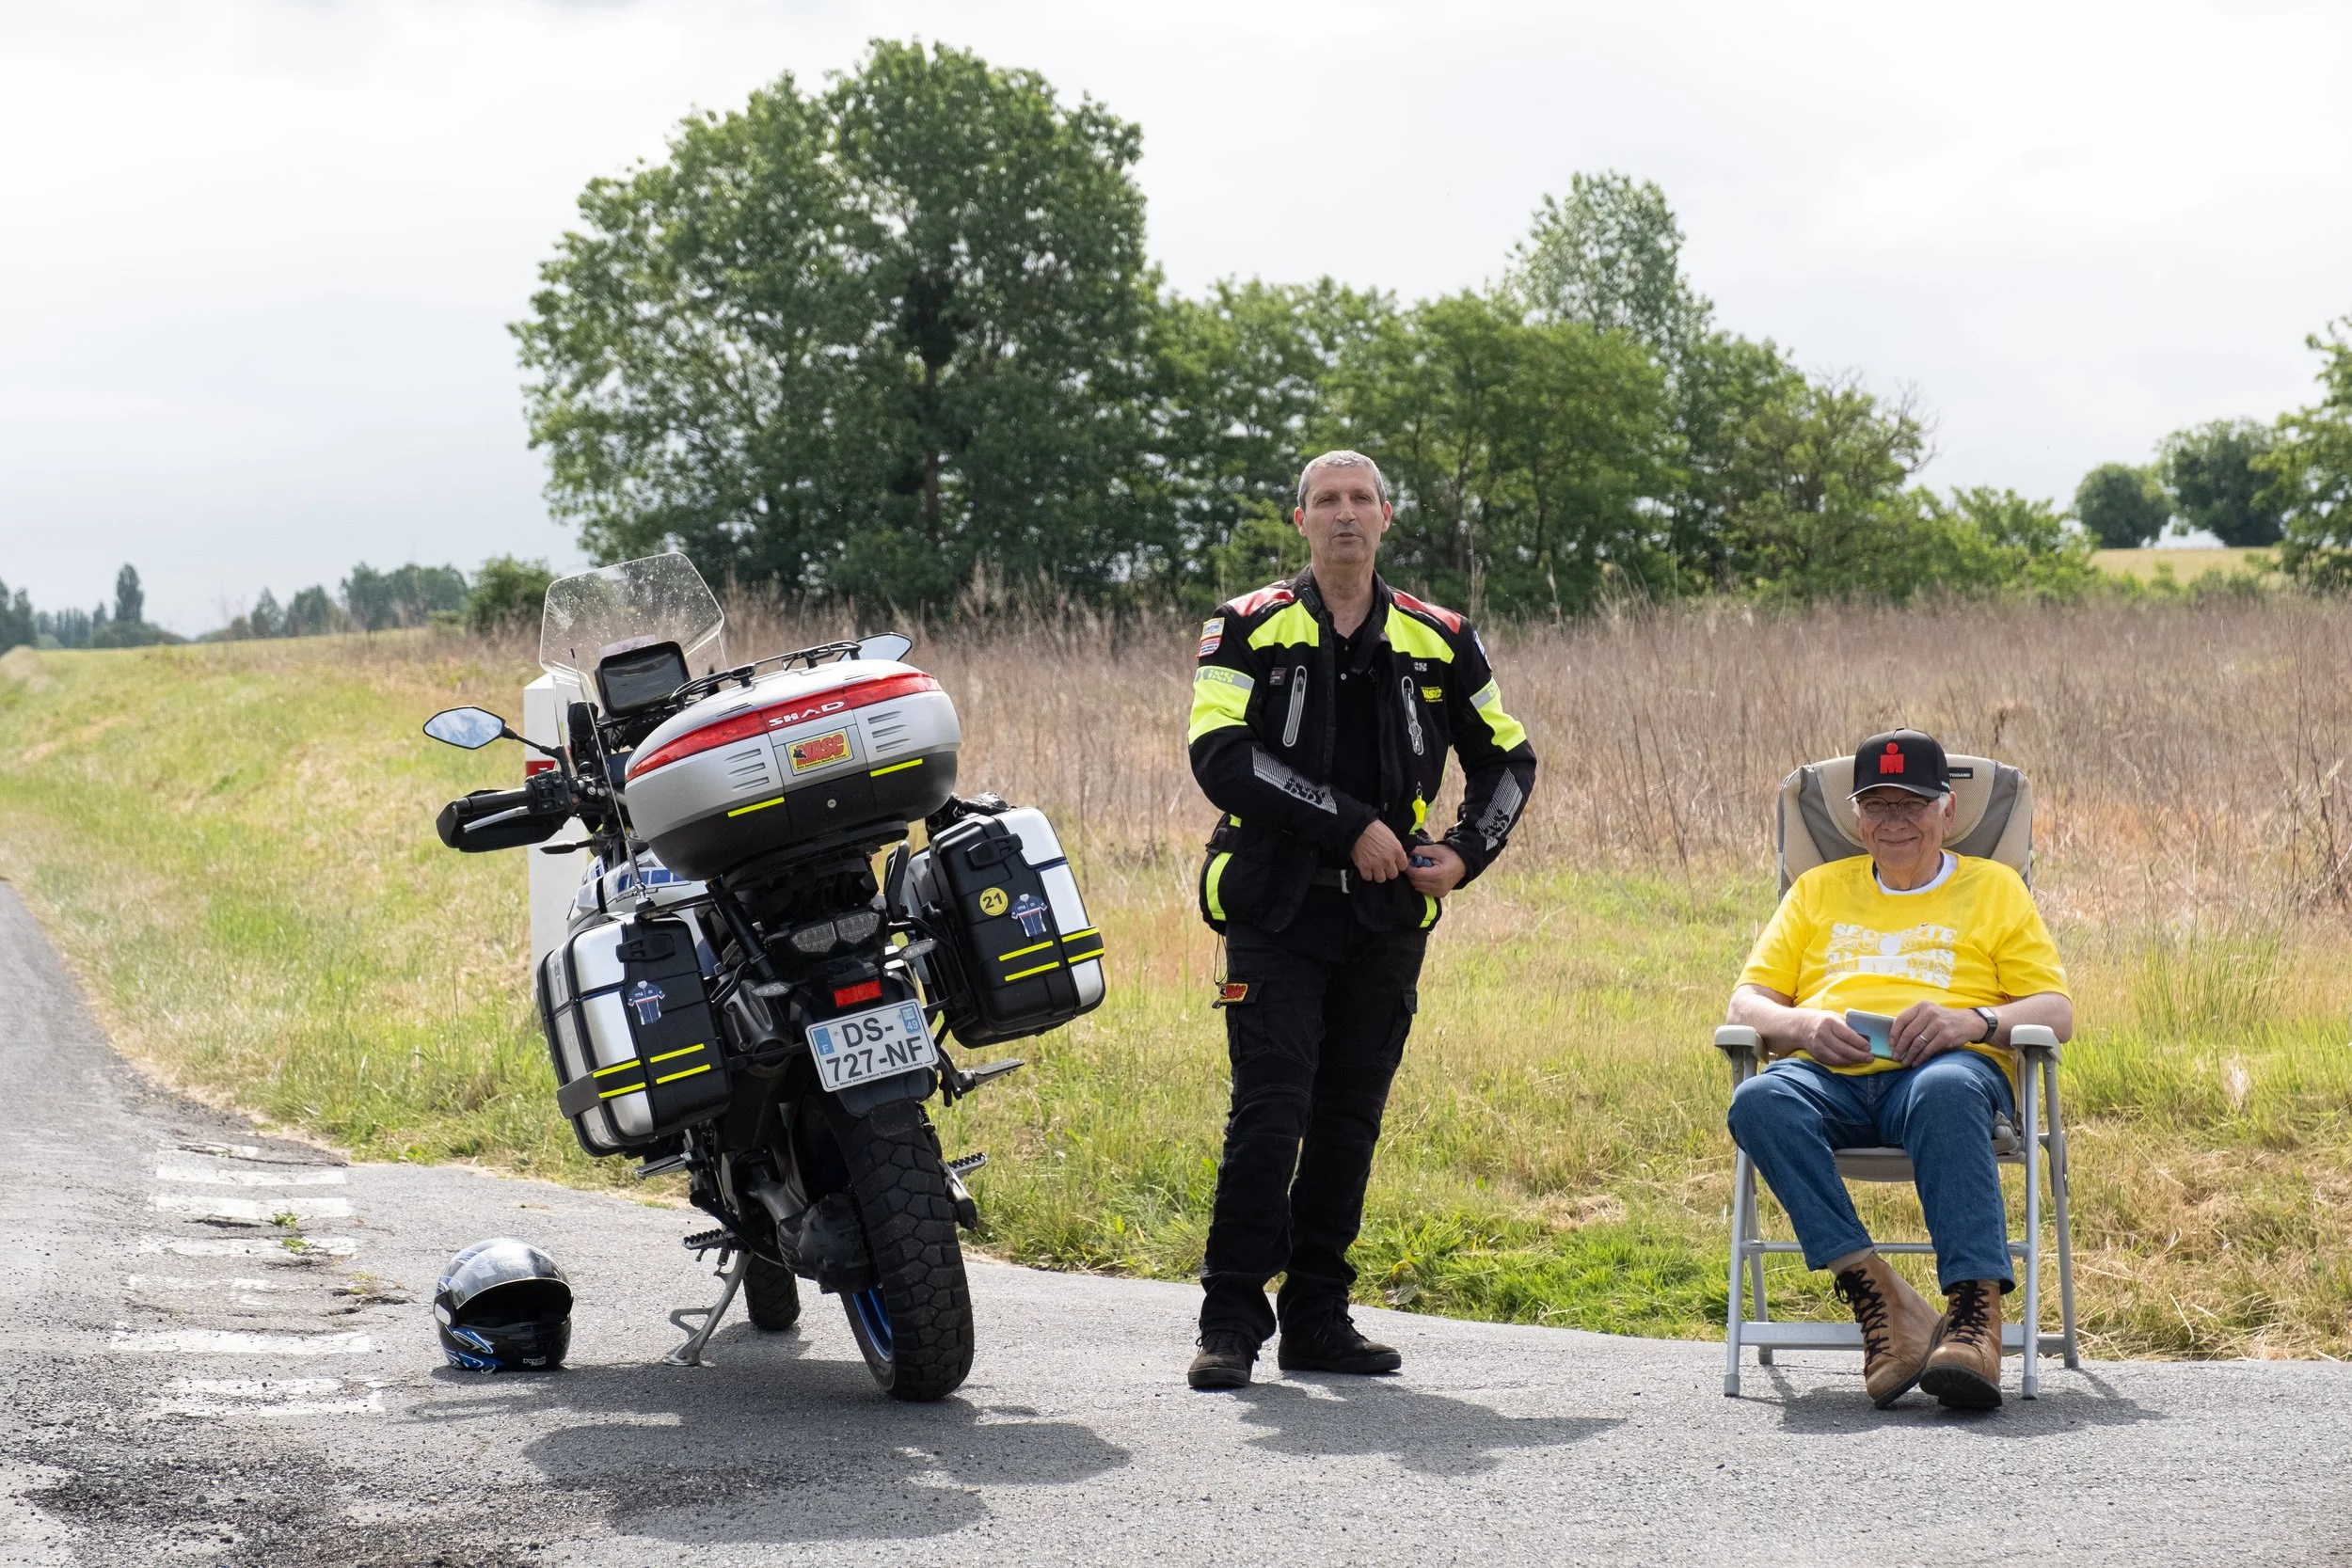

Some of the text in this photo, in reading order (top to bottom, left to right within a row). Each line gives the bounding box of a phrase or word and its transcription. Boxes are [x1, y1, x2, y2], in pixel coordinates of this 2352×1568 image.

[769, 701, 845, 727] SHAD
[982, 892, 1004, 910] 21
[907, 1020, 919, 1031] 49
[822, 1044, 829, 1053] F
[826, 1036, 923, 1082] 727-NF
